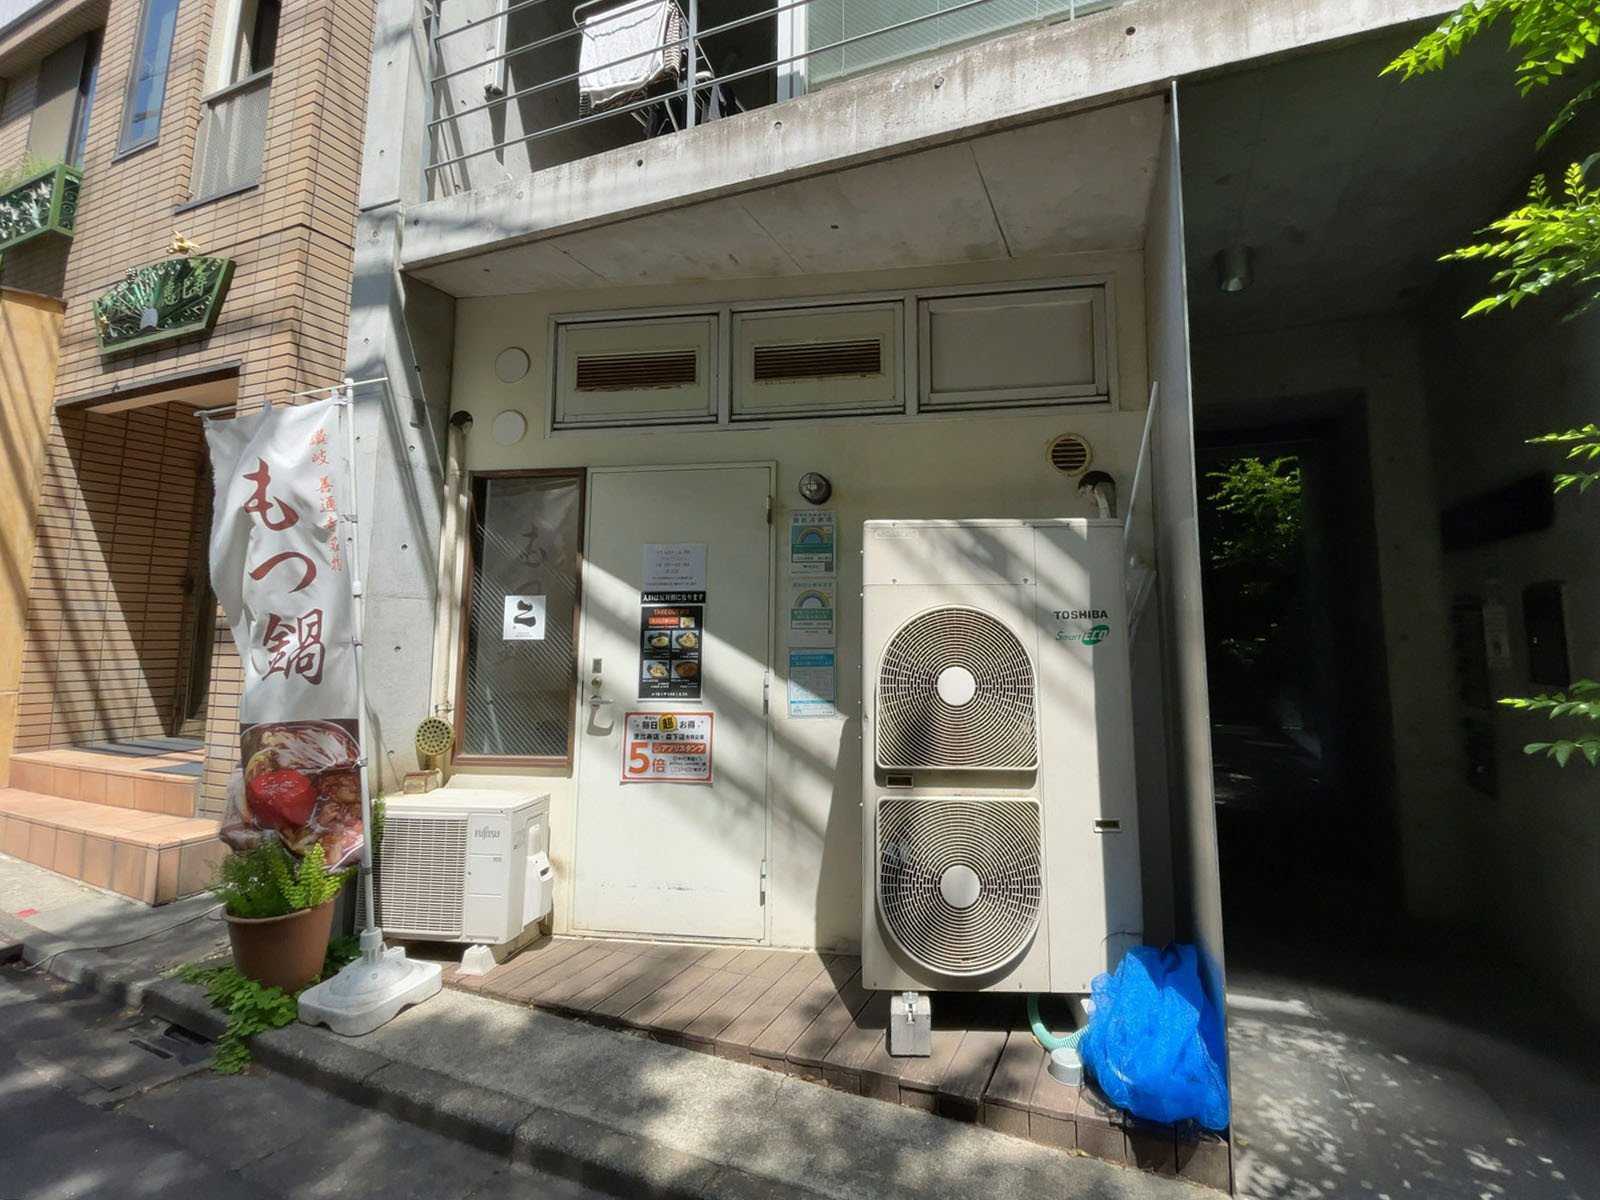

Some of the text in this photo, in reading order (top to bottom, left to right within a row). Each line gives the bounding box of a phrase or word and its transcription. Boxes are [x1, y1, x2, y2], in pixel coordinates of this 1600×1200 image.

[242, 456, 327, 685] もつ鍋
[1053, 610, 1108, 619] TOSHIBA
[661, 744, 704, 752] アプリスタンプ
[475, 826, 500, 839] FUJITSU
